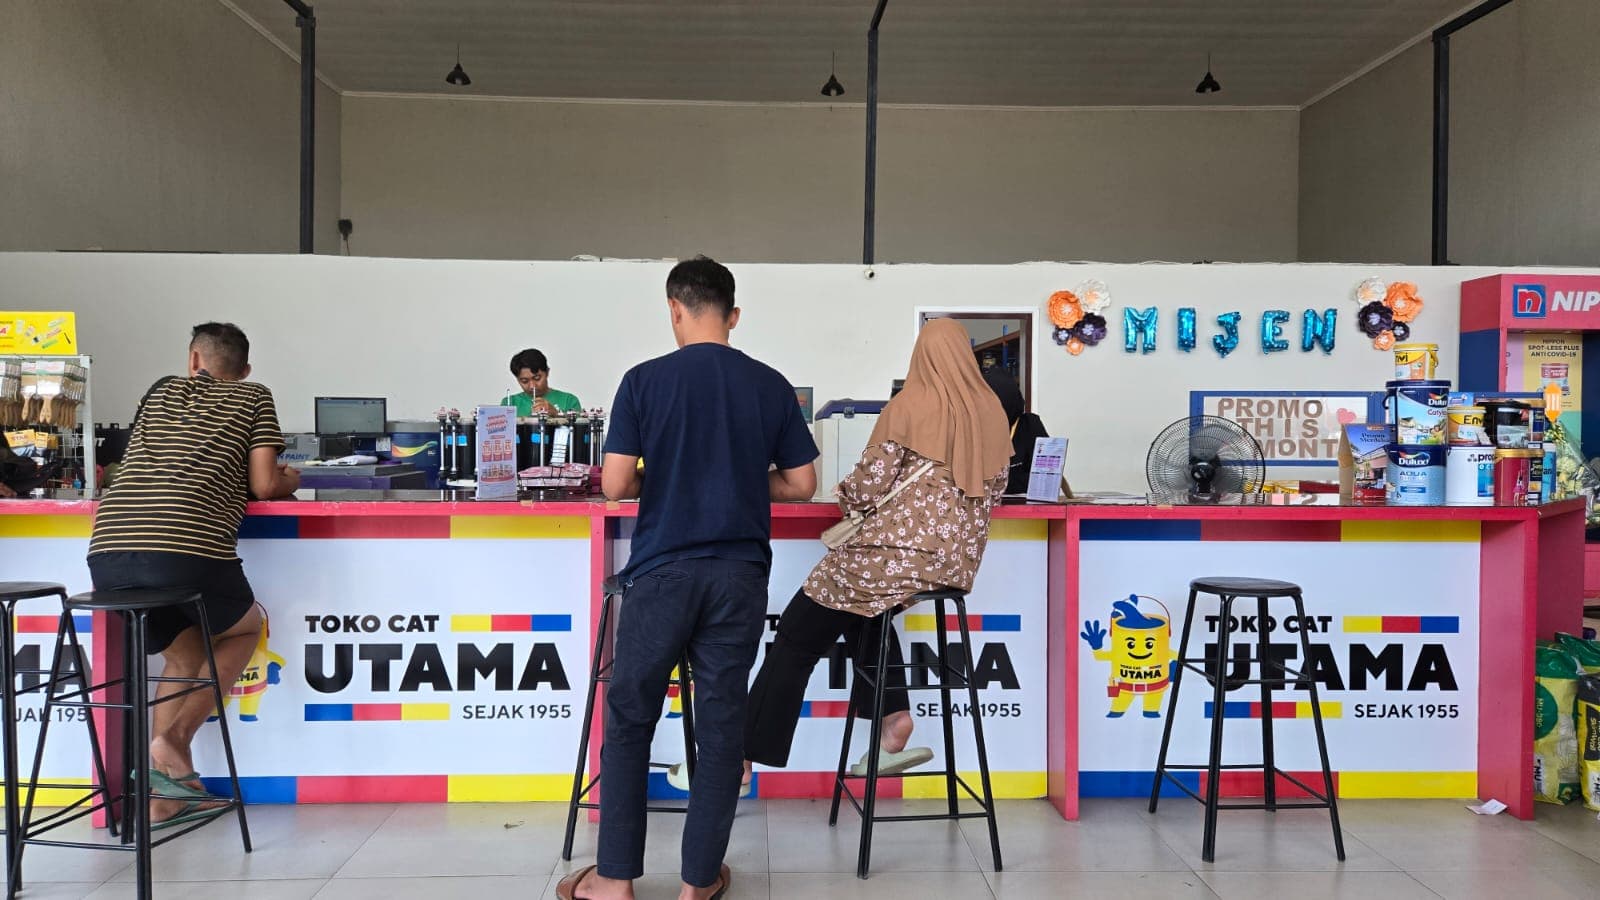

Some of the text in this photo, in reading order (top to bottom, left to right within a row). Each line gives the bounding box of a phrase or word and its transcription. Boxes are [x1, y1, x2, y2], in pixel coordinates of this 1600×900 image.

[1551, 290, 1600, 312] NIP
[1123, 305, 1338, 358] MIJEN
[1217, 398, 1323, 419] PROMO
[1235, 417, 1319, 439] THIS
[1258, 438, 1338, 459] MONT
[1398, 457, 1429, 465] Dulux
[305, 615, 440, 633] TOKO CAT
[1283, 615, 1333, 633] CAT
[304, 642, 571, 693] UTAMA
[1120, 669, 1162, 679] UTAMA
[1205, 643, 1458, 692] UTAMA
[463, 704, 571, 719] SEJAK 1955
[916, 703, 1021, 718] SEAK 1955
[1354, 704, 1459, 719] SEJAK 1955
